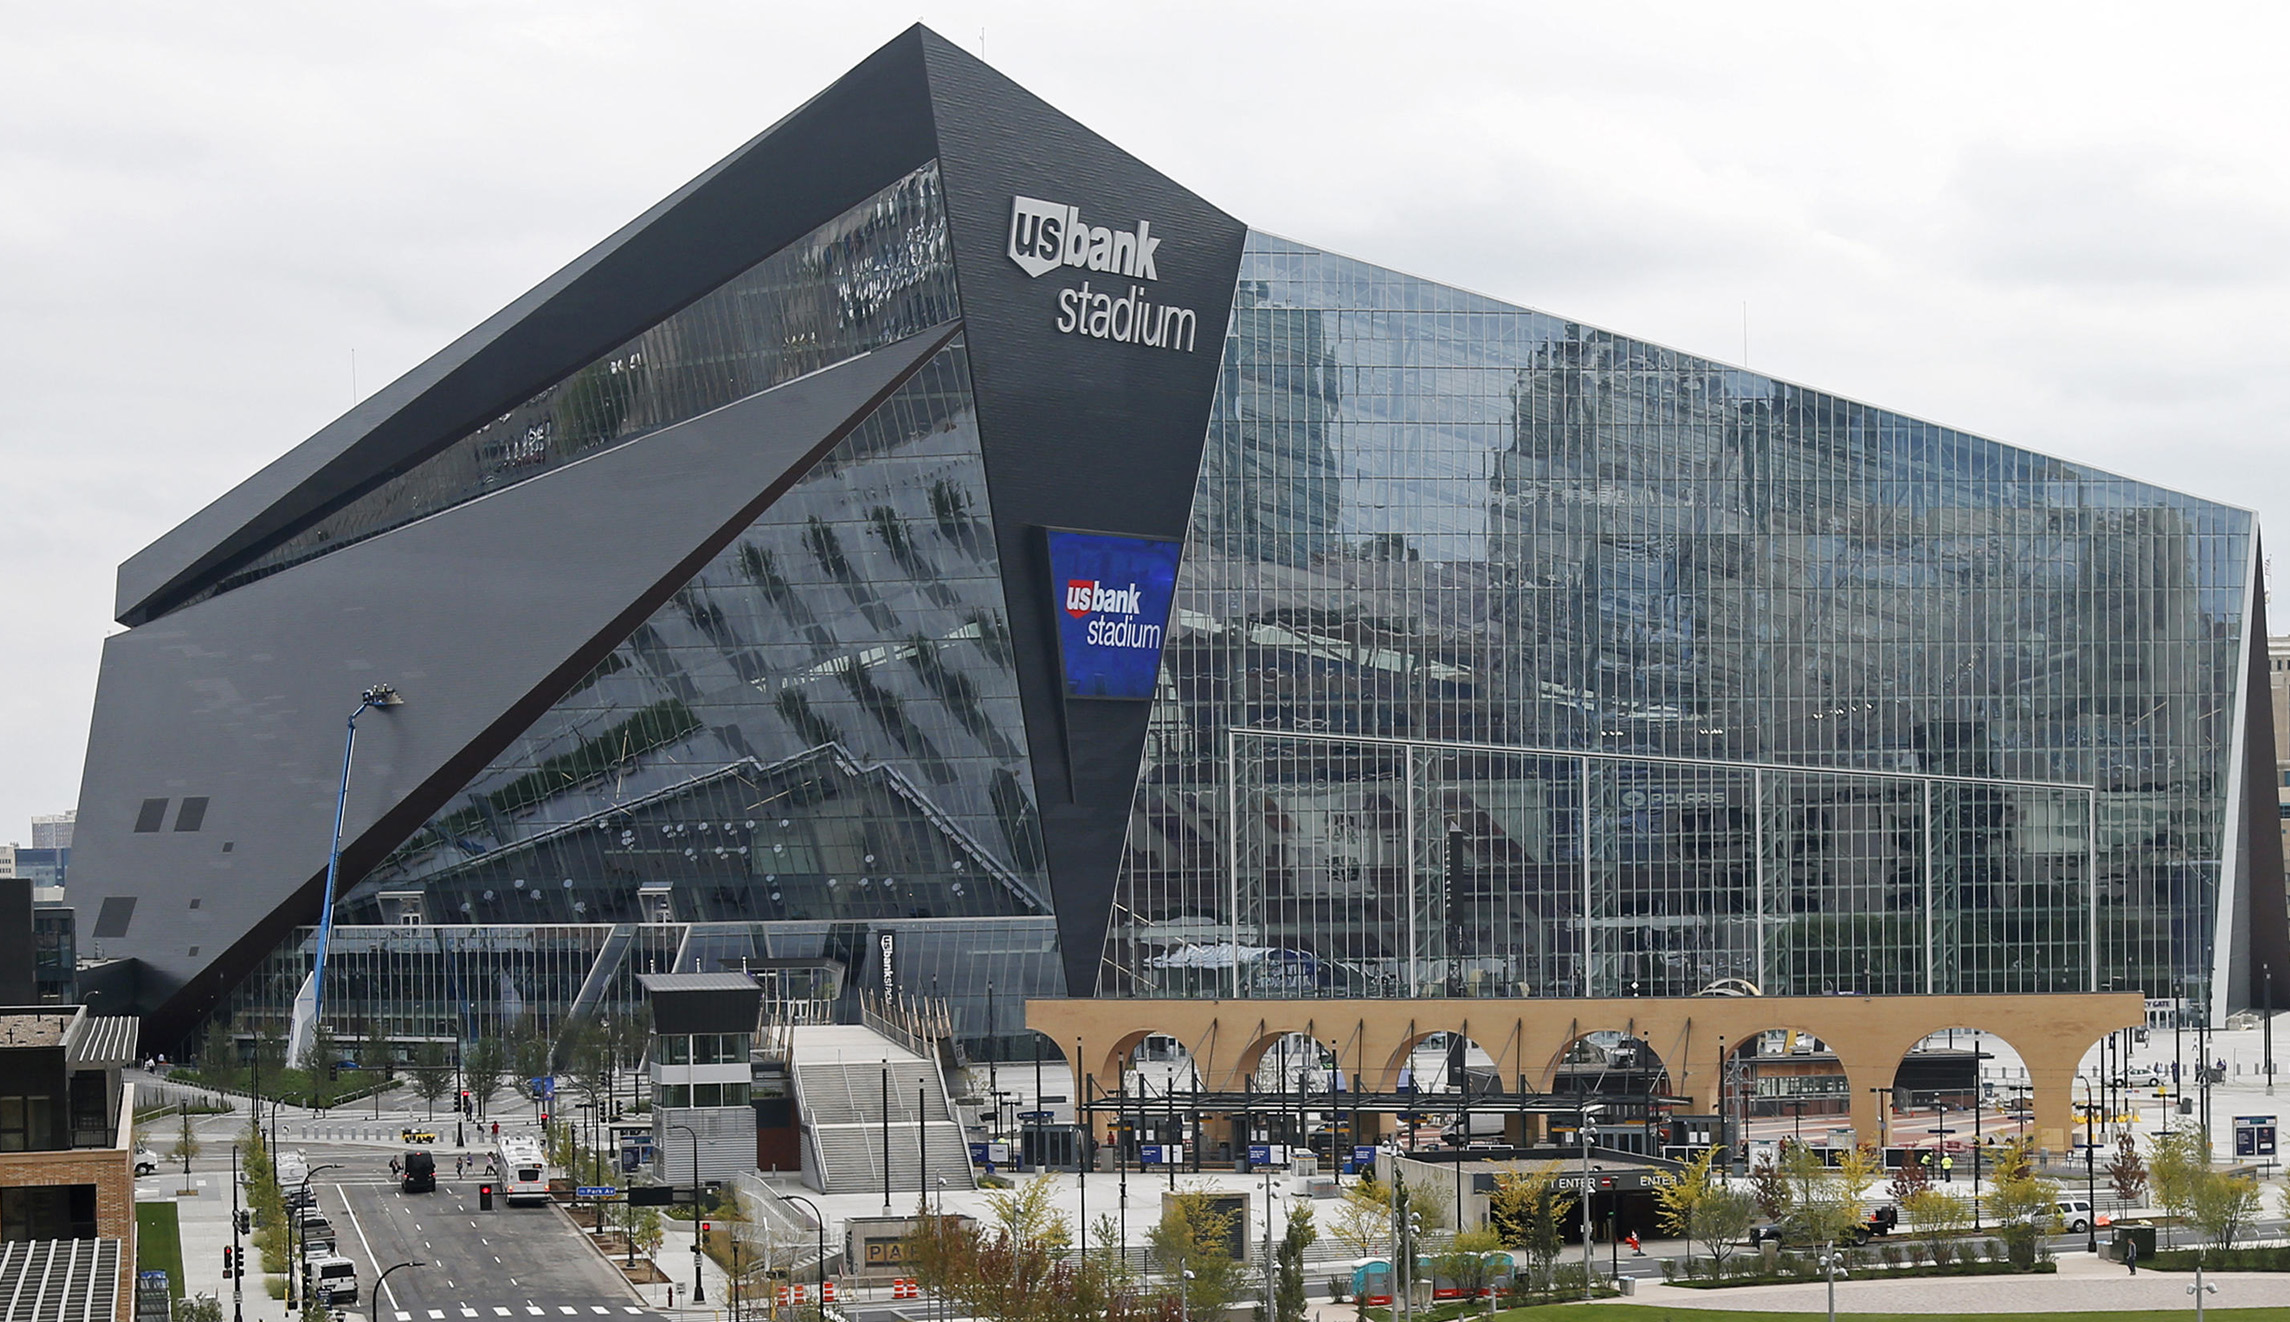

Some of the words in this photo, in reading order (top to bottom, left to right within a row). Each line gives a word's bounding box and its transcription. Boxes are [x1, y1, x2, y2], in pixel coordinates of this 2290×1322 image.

[1056, 280, 1197, 353] stadium
[1086, 615, 1161, 649] stadium
[1651, 792, 1725, 804] POLARS
[1559, 1177, 1596, 1189] ENTER
[1640, 1175, 1677, 1187] ENTER
